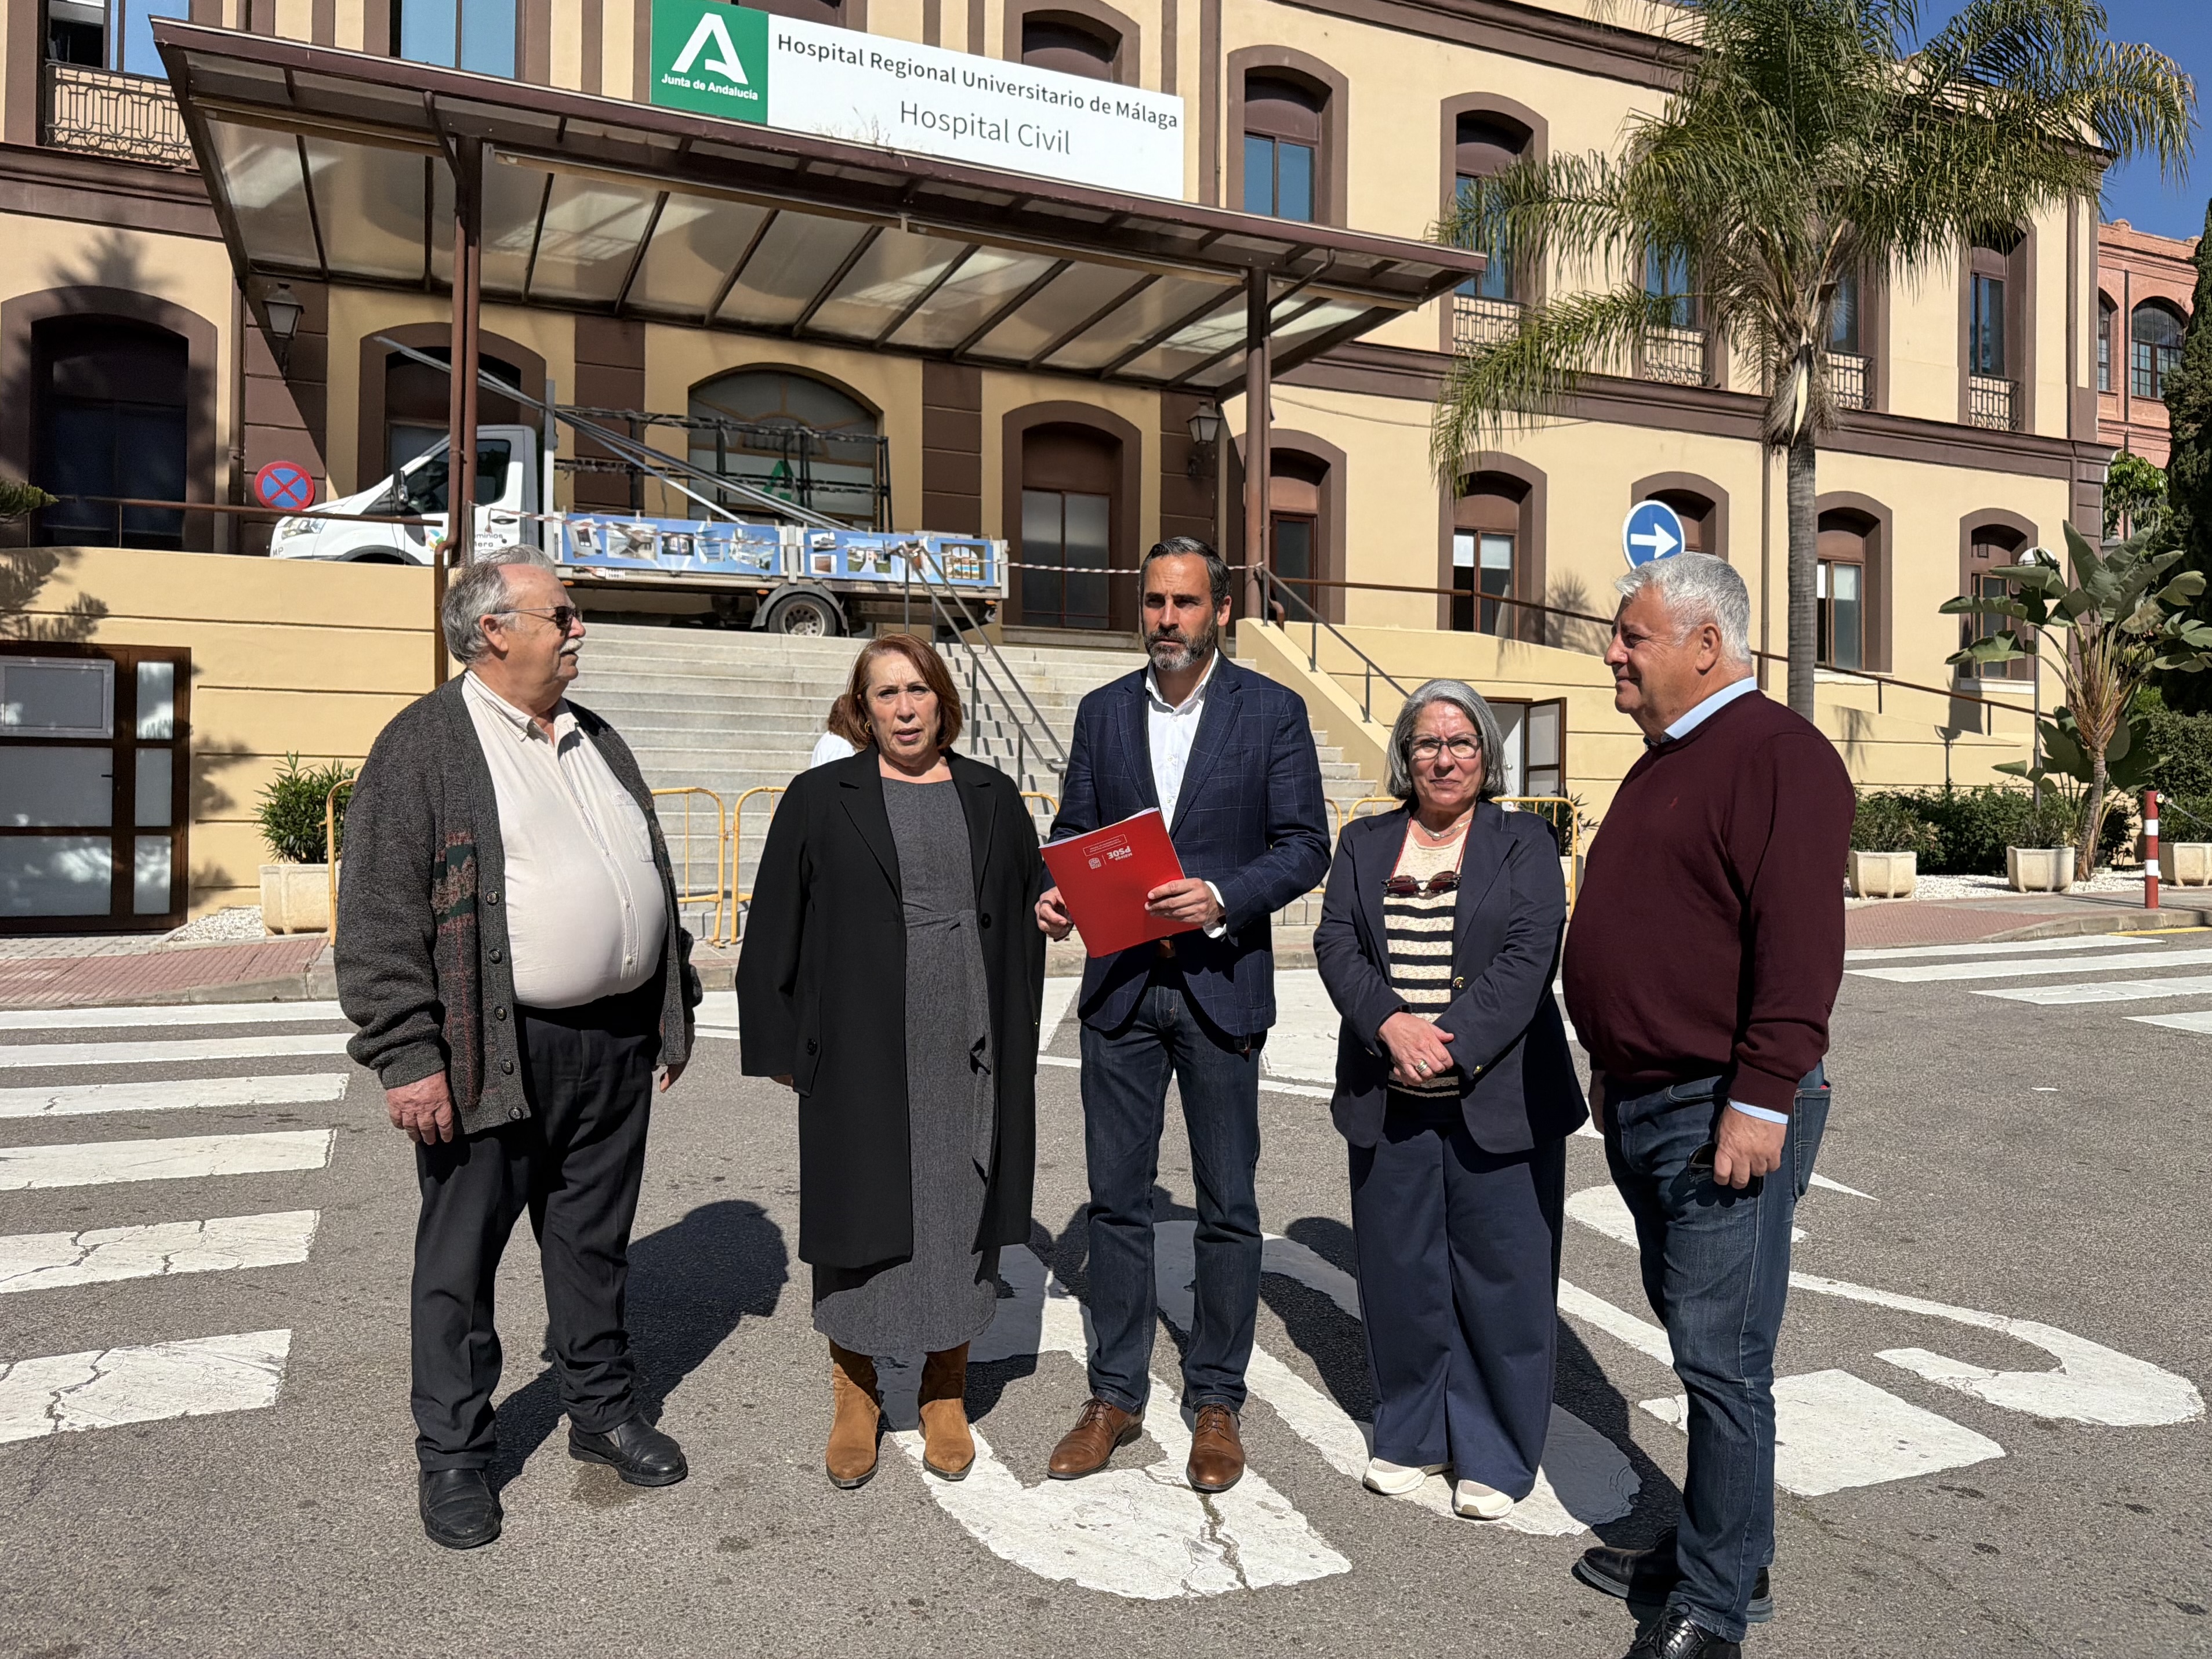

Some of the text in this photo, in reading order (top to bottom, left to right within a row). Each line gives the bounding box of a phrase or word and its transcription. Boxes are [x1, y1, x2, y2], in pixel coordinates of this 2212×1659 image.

[661, 73, 691, 88] Junta
[692, 79, 706, 91] de
[778, 34, 1178, 130] Hospital Regional Universitario de Málaga
[901, 100, 1071, 155] Hospital Civil
[1106, 845, 1131, 859] PSOE
